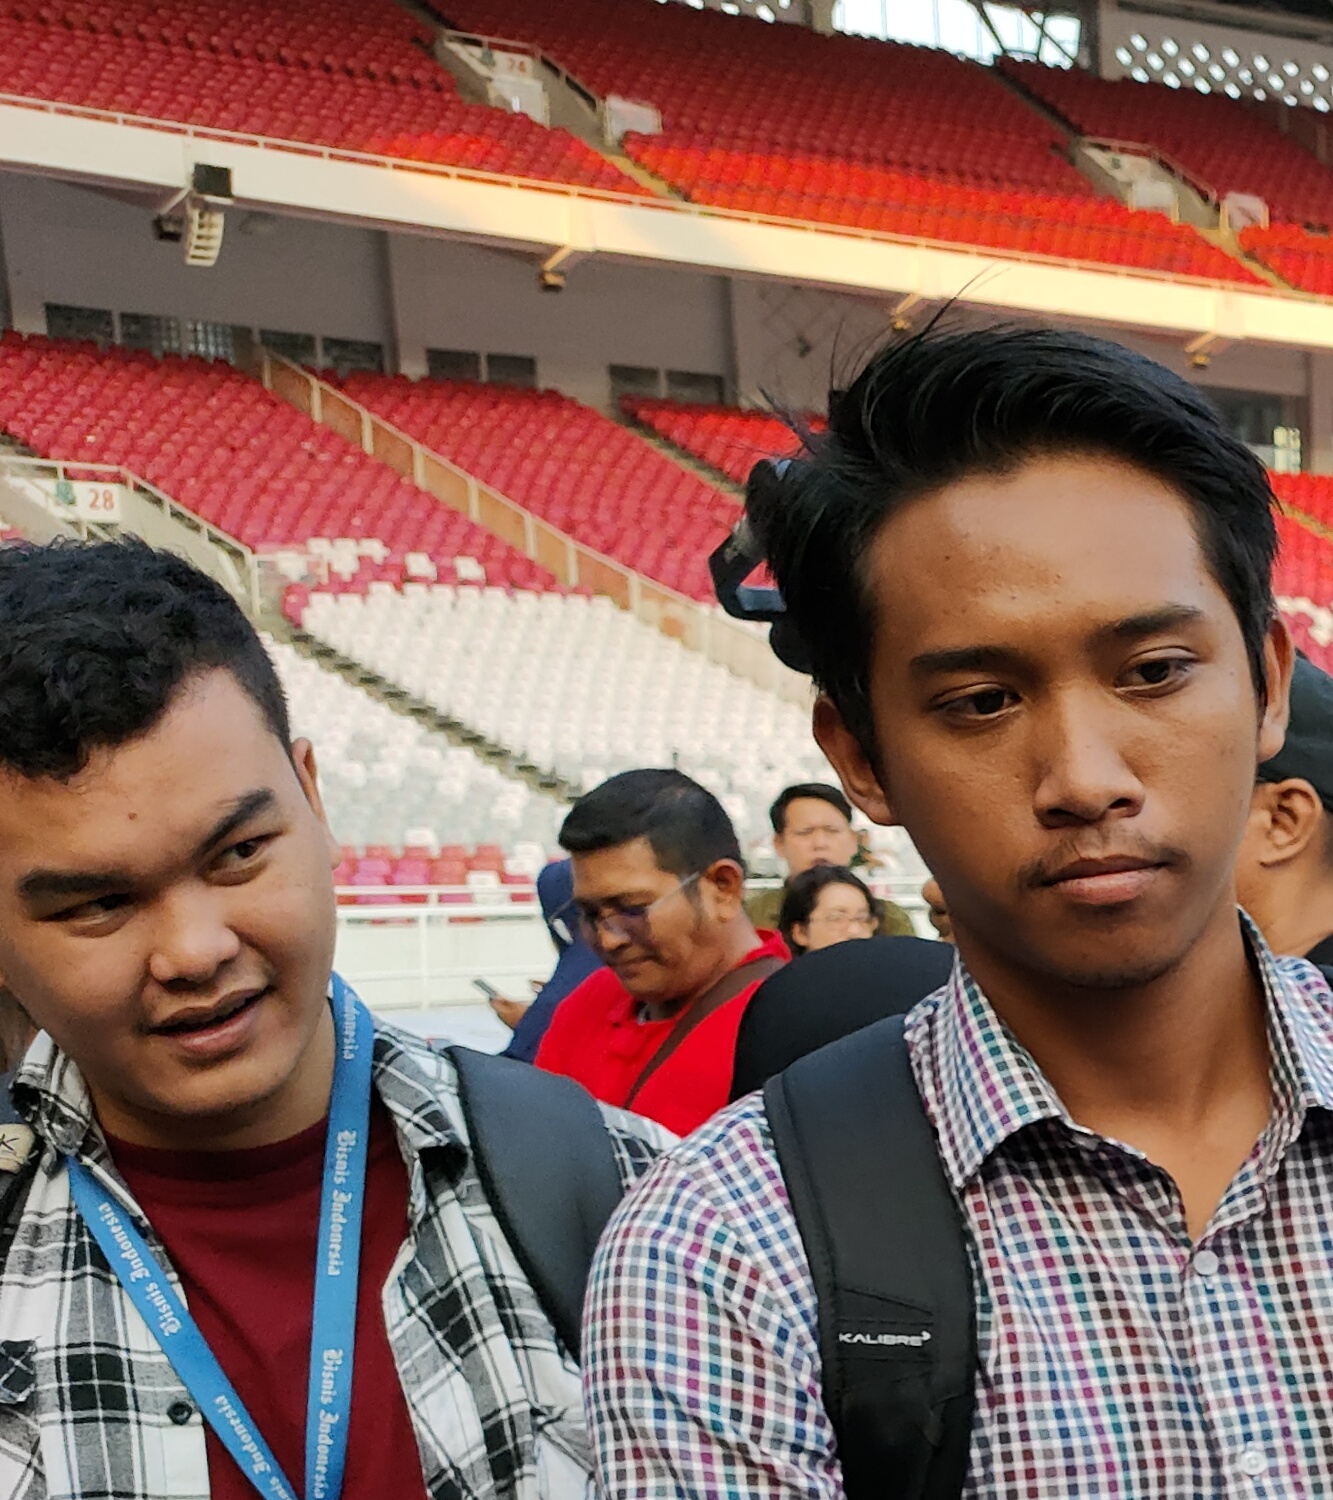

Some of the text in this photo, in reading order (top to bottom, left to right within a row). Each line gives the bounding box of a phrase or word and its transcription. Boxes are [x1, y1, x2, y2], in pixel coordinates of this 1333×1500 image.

[88, 488, 115, 510] 28
[327, 1188, 353, 1277] Indonesia
[838, 1331, 931, 1347] KALIBRE
[313, 1408, 340, 1500] Indonesia
